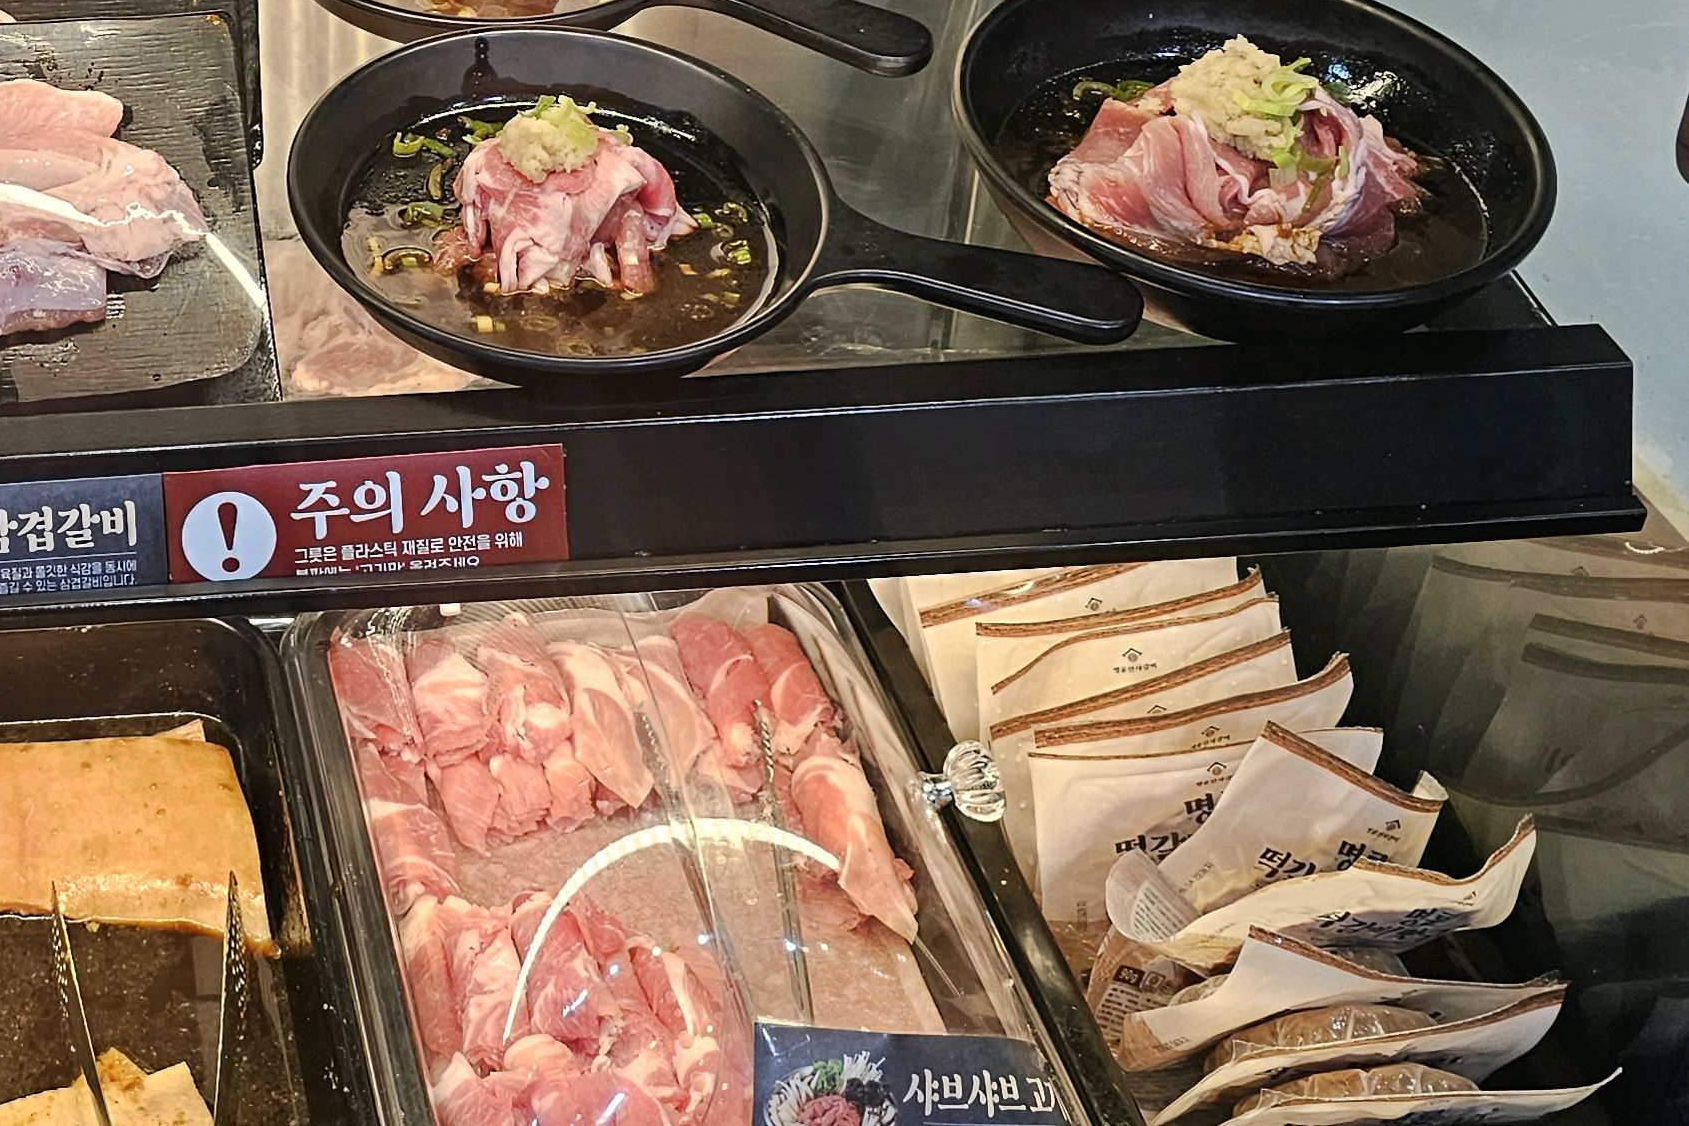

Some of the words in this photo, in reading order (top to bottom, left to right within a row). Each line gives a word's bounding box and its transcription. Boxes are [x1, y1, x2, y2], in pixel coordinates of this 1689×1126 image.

[290, 471, 404, 540] 주의
[420, 461, 550, 528] 사항
[295, 546, 337, 564] 그릇은
[341, 541, 398, 561] 플라스틱
[402, 537, 444, 556] 재질로
[448, 533, 490, 551] 안전을
[494, 531, 523, 548] 위해
[23, 581, 33, 592] 수
[36, 579, 57, 592] 있는
[1119, 968, 1139, 984] 90g
[902, 1068, 1027, 1118] 샤브샤브
